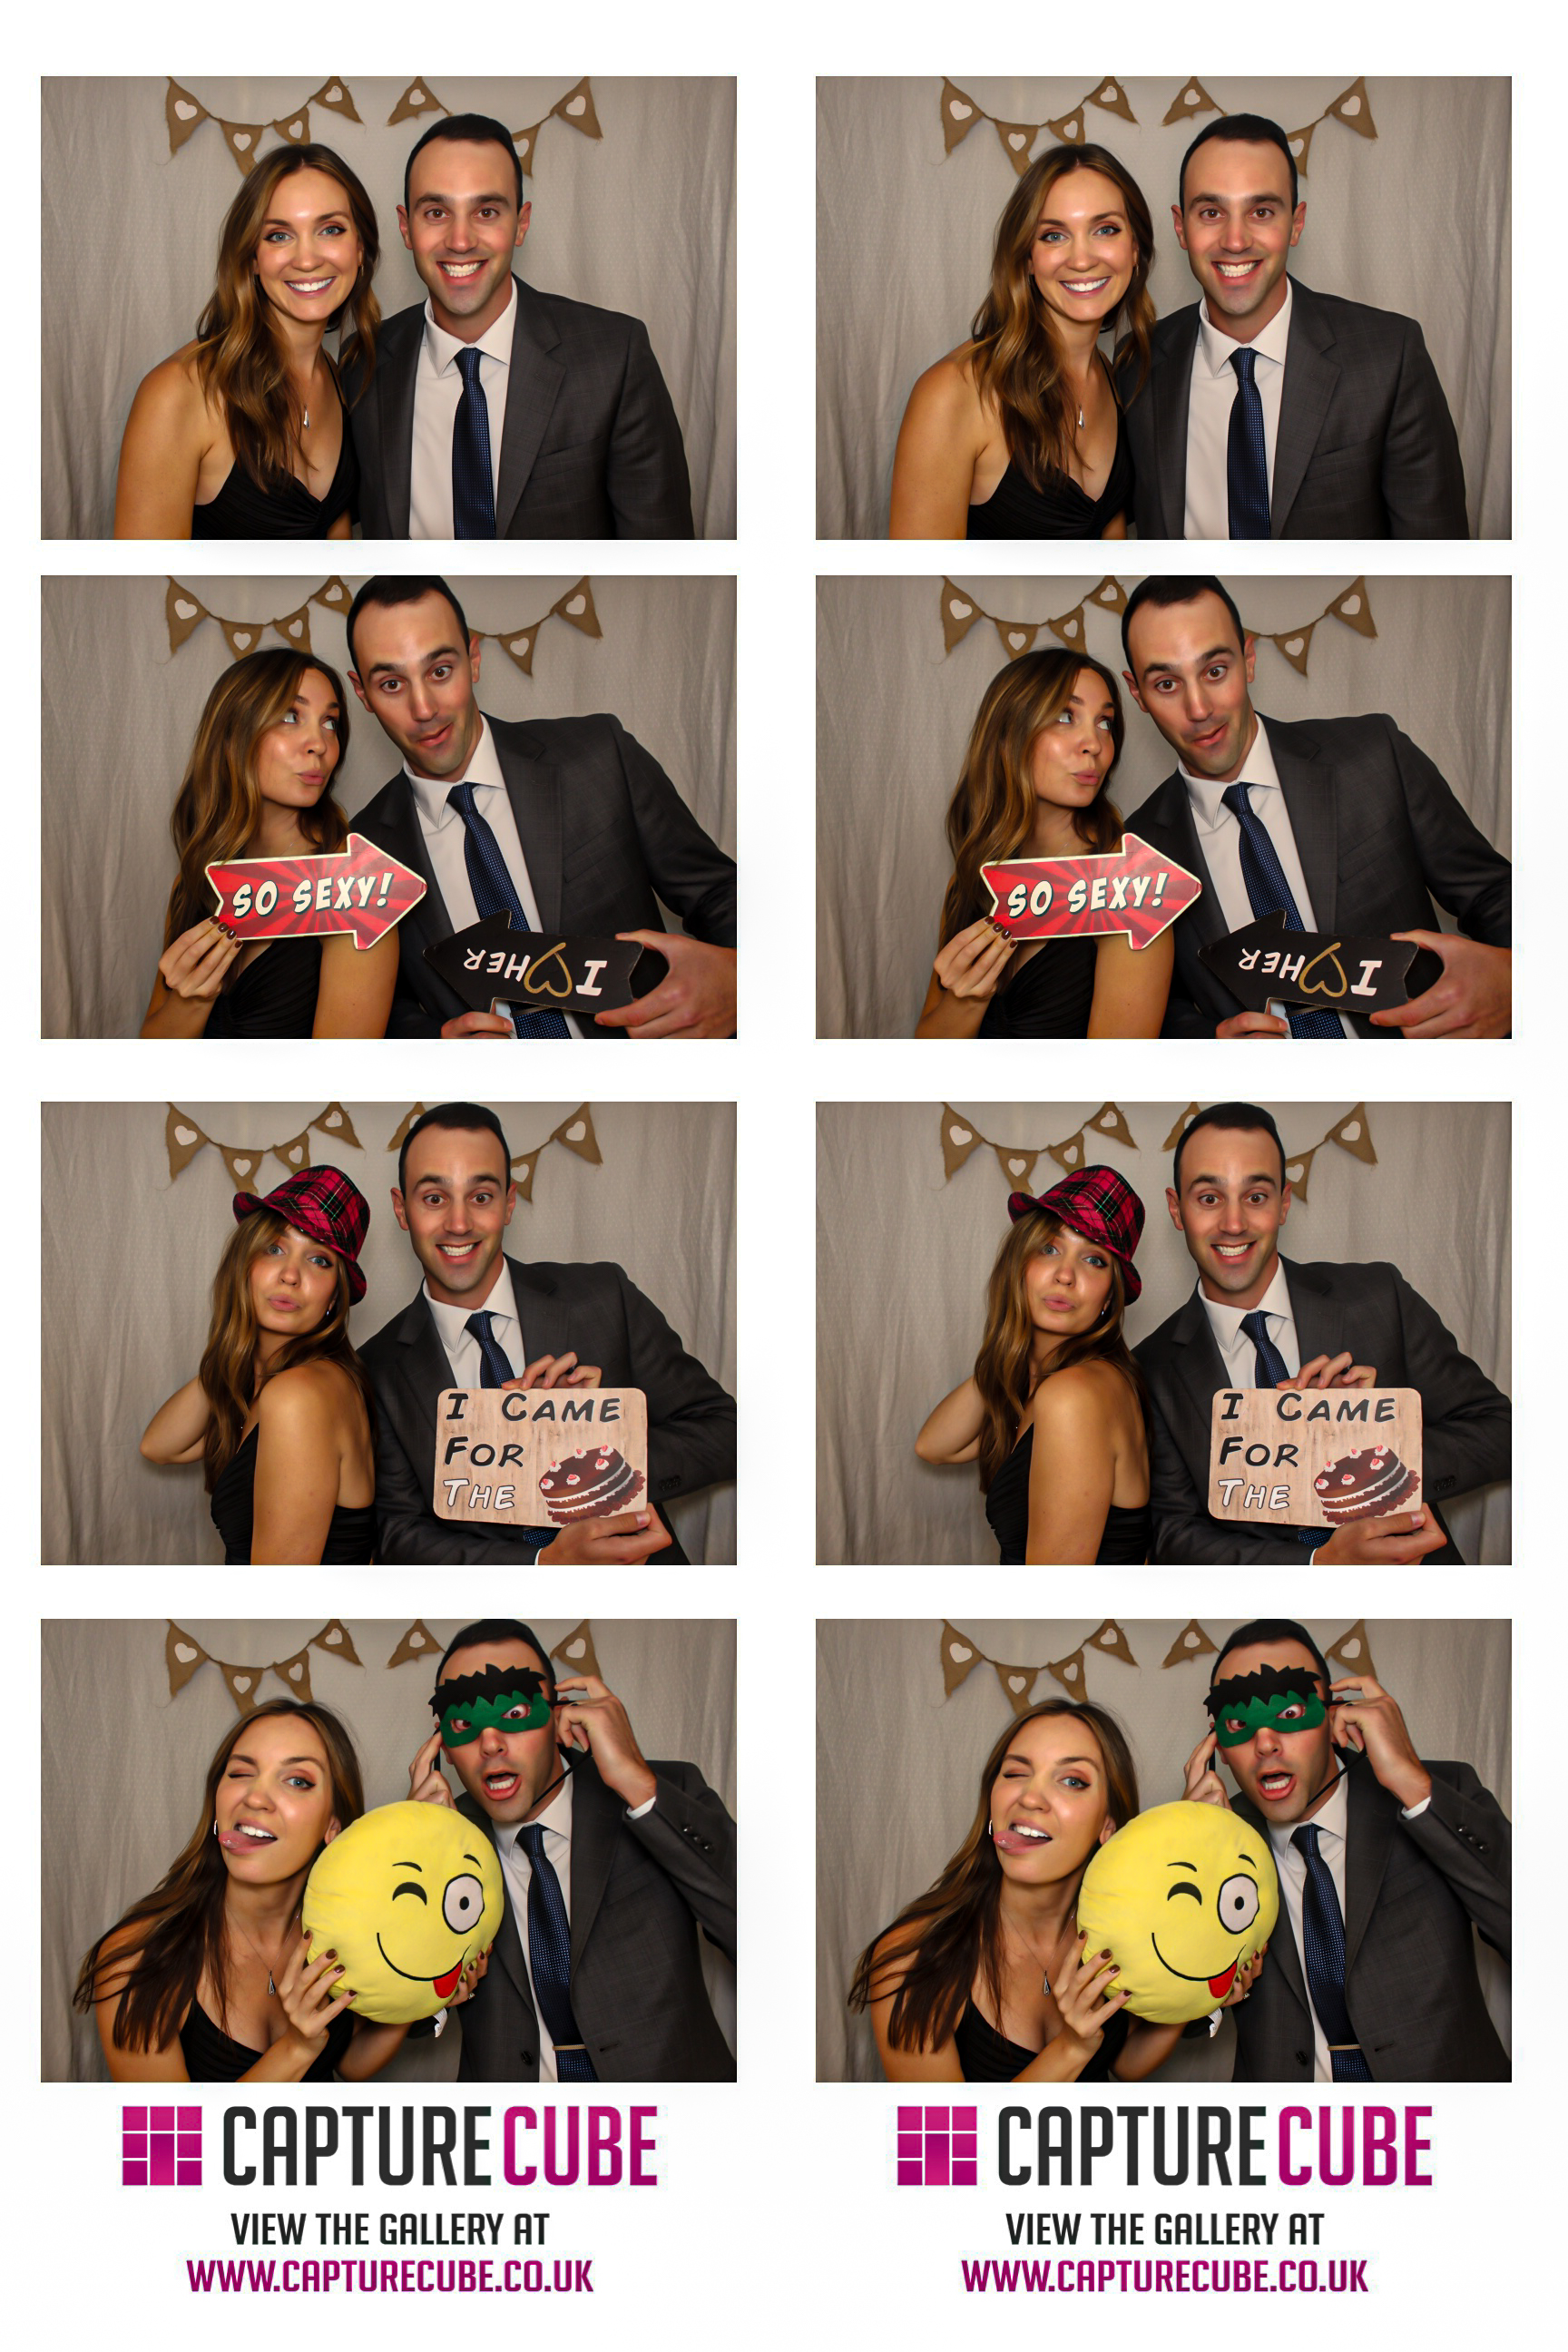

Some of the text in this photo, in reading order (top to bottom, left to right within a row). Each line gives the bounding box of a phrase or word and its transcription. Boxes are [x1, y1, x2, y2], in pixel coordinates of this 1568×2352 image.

[232, 872, 394, 918] SO SEXY!
[1007, 872, 1169, 918] SO SEXY!
[463, 947, 608, 996] I HER
[1238, 947, 1383, 996] I HER
[446, 1392, 621, 1423] I CAME
[1220, 1392, 1396, 1423] I CAME
[444, 1436, 524, 1468] FOR
[1219, 1436, 1299, 1468] FOR
[443, 1478, 515, 1510] THE
[1218, 1478, 1290, 1510] THE
